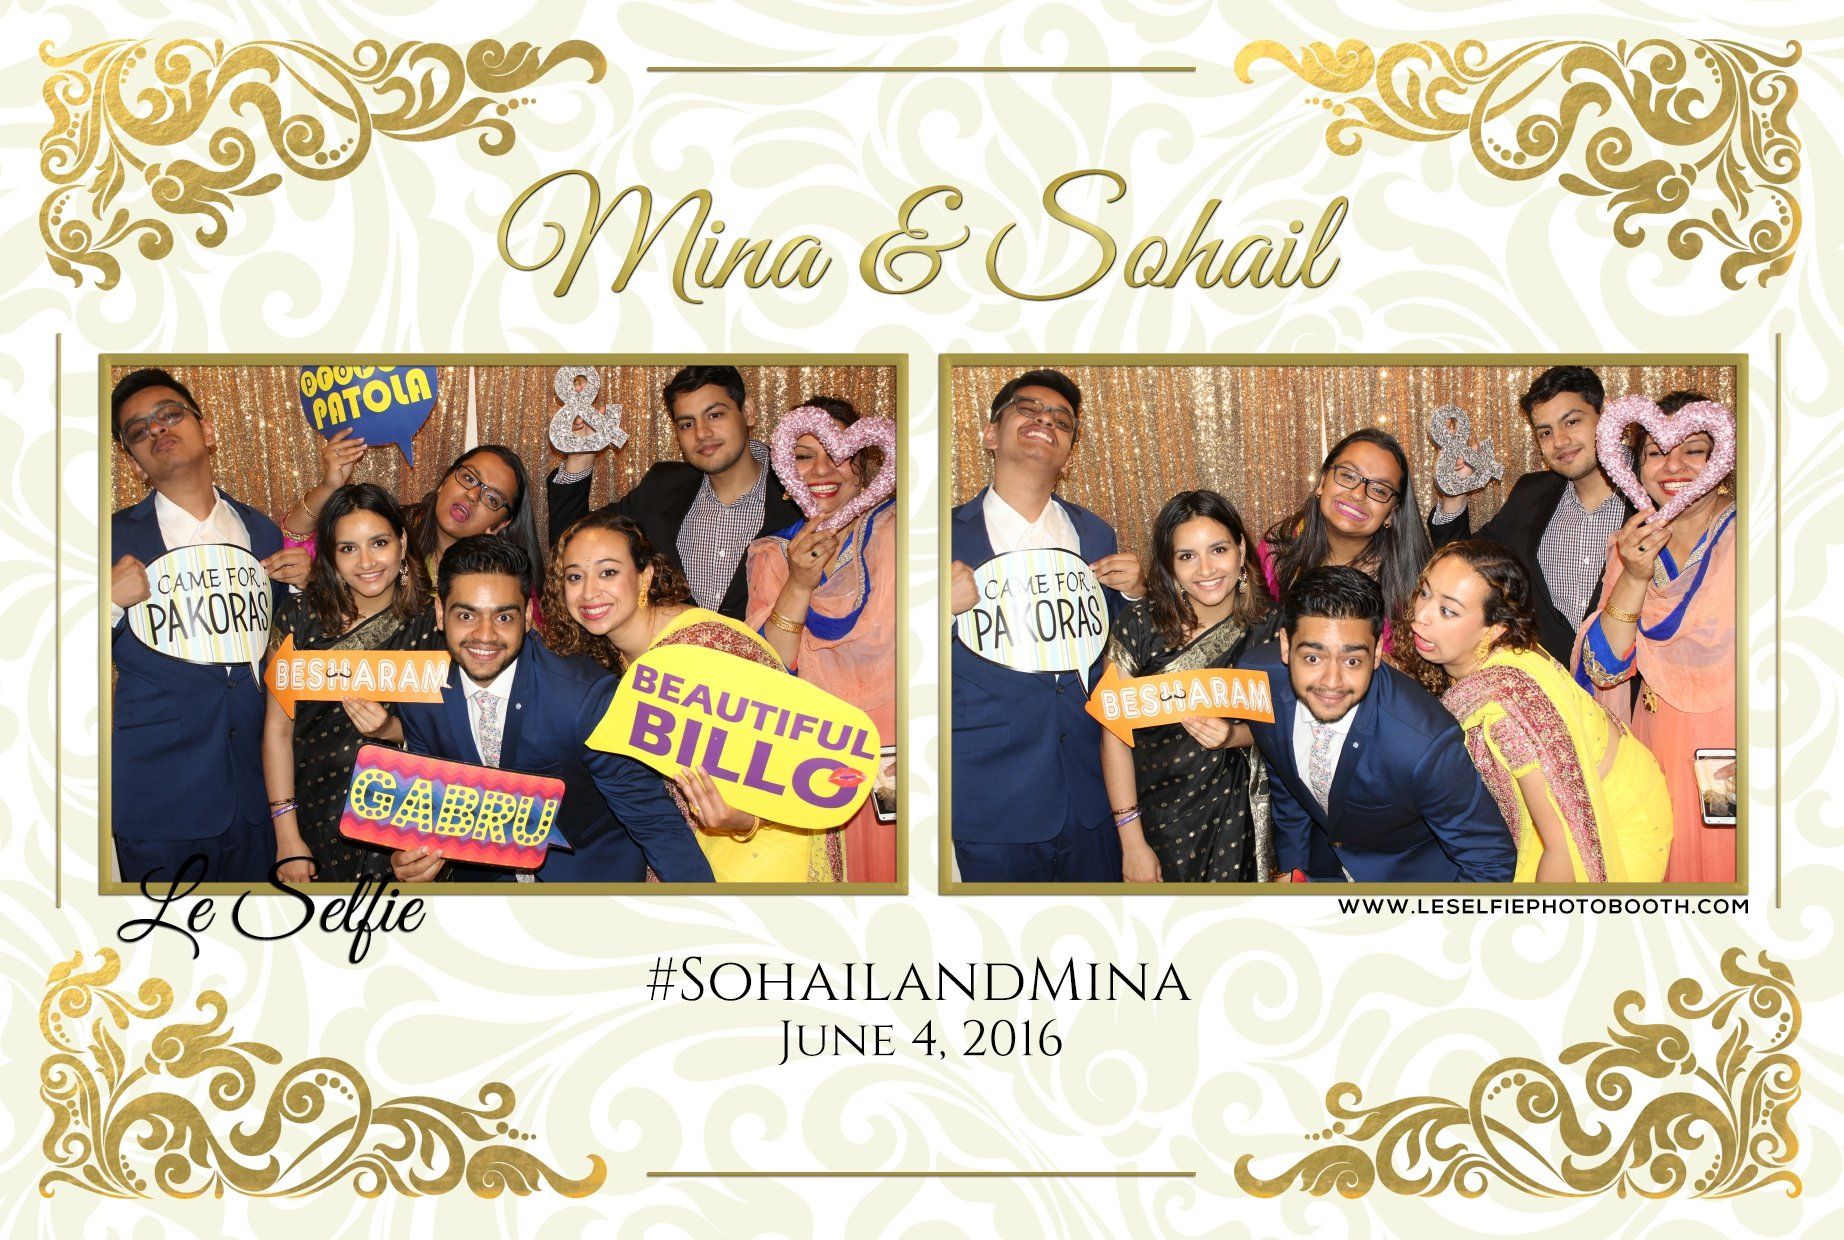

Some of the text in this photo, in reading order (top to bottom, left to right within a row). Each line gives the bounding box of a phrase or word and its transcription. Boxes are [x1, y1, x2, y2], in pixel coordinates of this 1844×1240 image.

[312, 368, 433, 430] PATOLA
[157, 568, 222, 595] CAME
[984, 574, 1050, 600] CAME
[146, 590, 269, 646] PAKORAS
[972, 594, 1104, 652] PAKORAS
[275, 658, 451, 694] BESHARAM
[1100, 676, 1273, 721] BESHARAM
[631, 663, 876, 761] BEAUTIFUL
[628, 700, 867, 809] BILLO
[350, 768, 559, 847] GABRU
